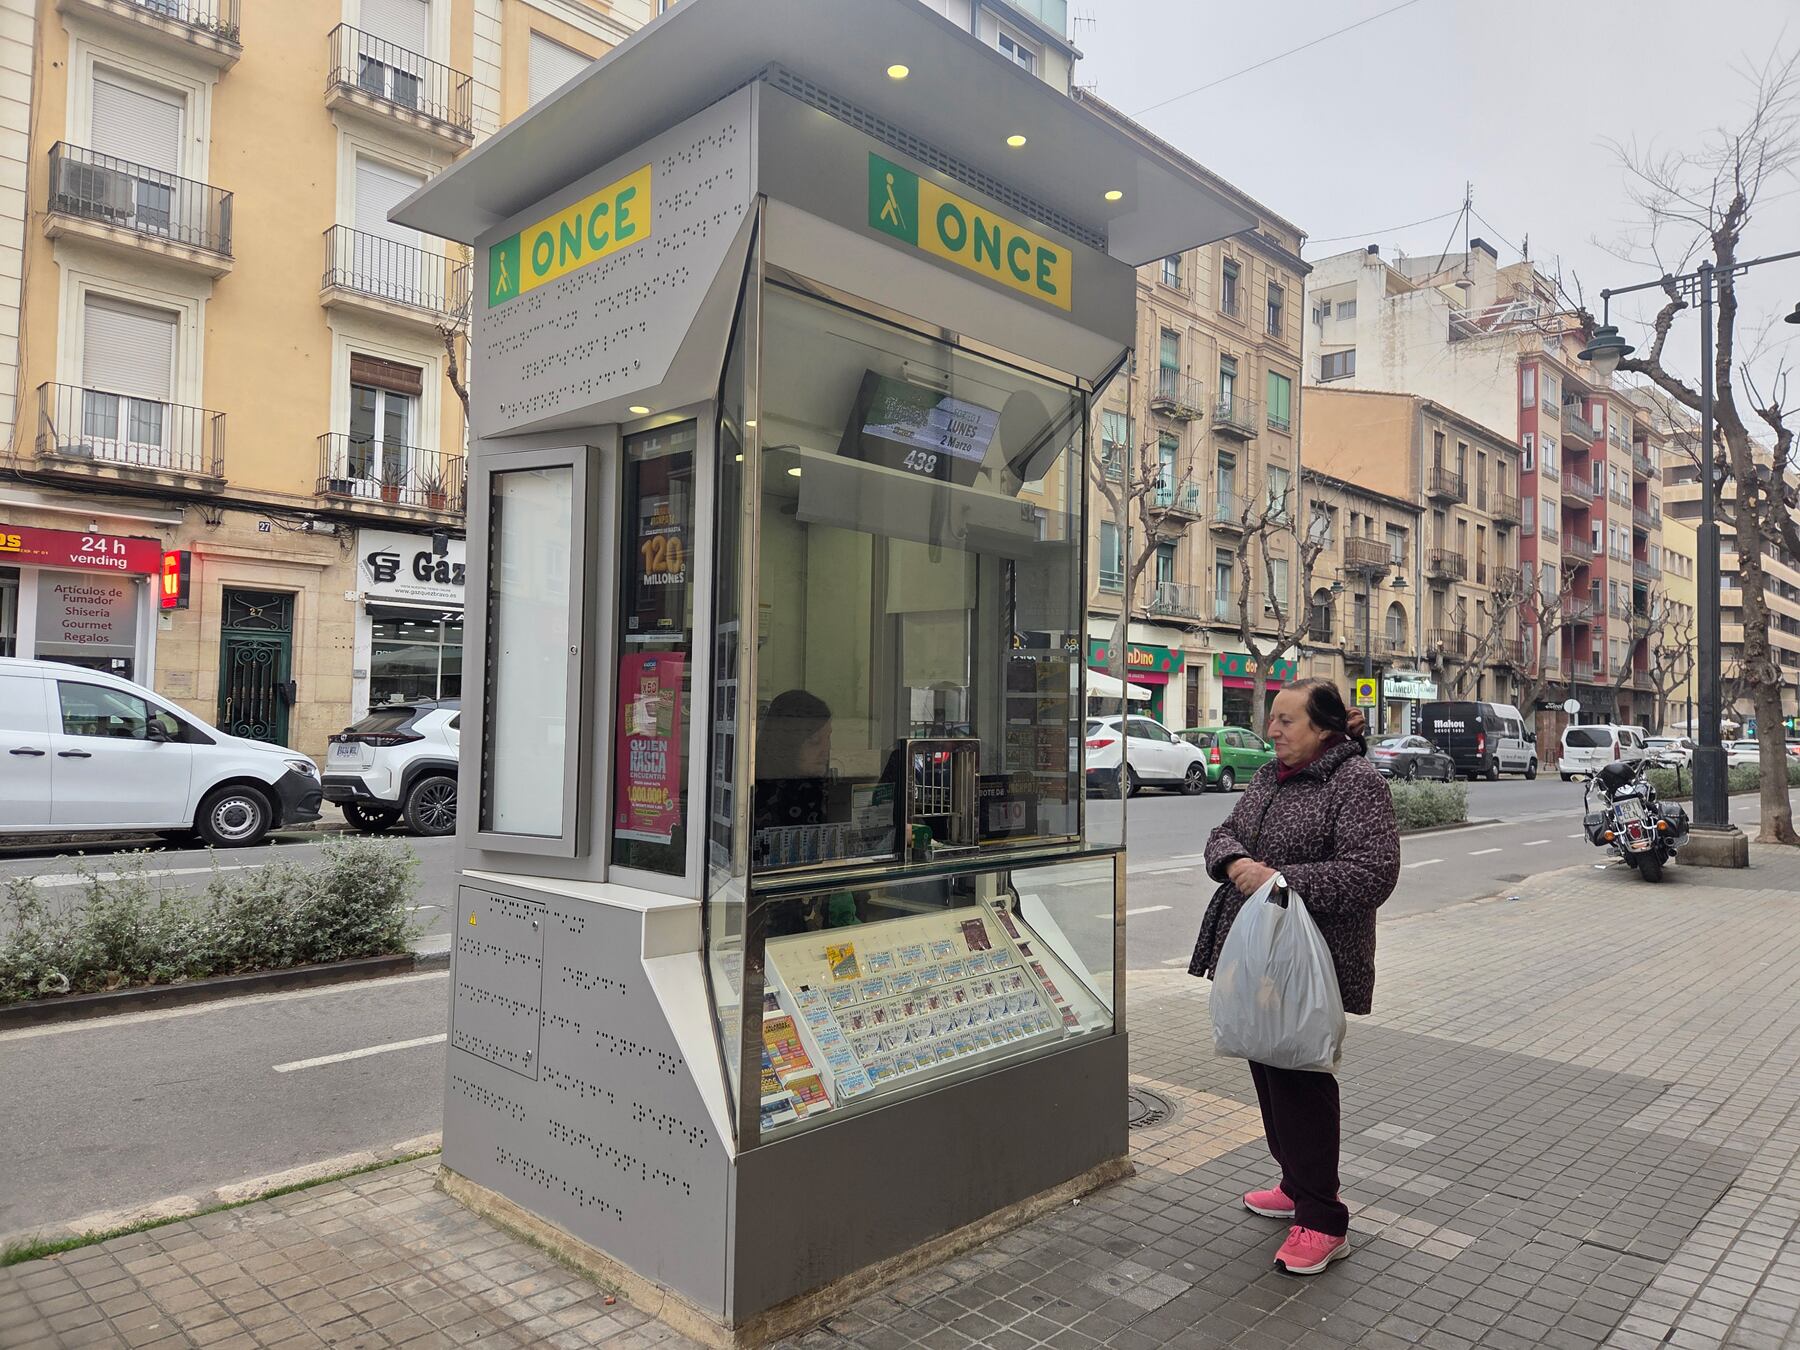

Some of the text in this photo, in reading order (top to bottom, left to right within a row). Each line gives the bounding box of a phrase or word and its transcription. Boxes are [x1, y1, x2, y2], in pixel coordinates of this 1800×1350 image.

[532, 185, 637, 277] ONCE
[936, 202, 1058, 296] ONCE
[946, 419, 978, 439] LUNES
[940, 434, 973, 452] 2 Marzo
[903, 449, 938, 473] 438
[259, 523, 270, 532] 27
[81, 536, 126, 555] 24 h
[70, 554, 128, 570] vending
[641, 534, 684, 576] 120
[643, 571, 685, 586] MILLONES
[54, 584, 123, 598] Artículos de
[63, 594, 114, 606] Fumador
[65, 606, 110, 618] Shiseria
[250, 607, 263, 616] 27
[62, 619, 112, 631] Gourmet
[64, 632, 110, 644] Regalos
[1434, 719, 1465, 728] Mahou
[630, 738, 668, 752] QUIEN
[630, 750, 667, 774] RASCA
[629, 772, 667, 781] ENCUENTRA
